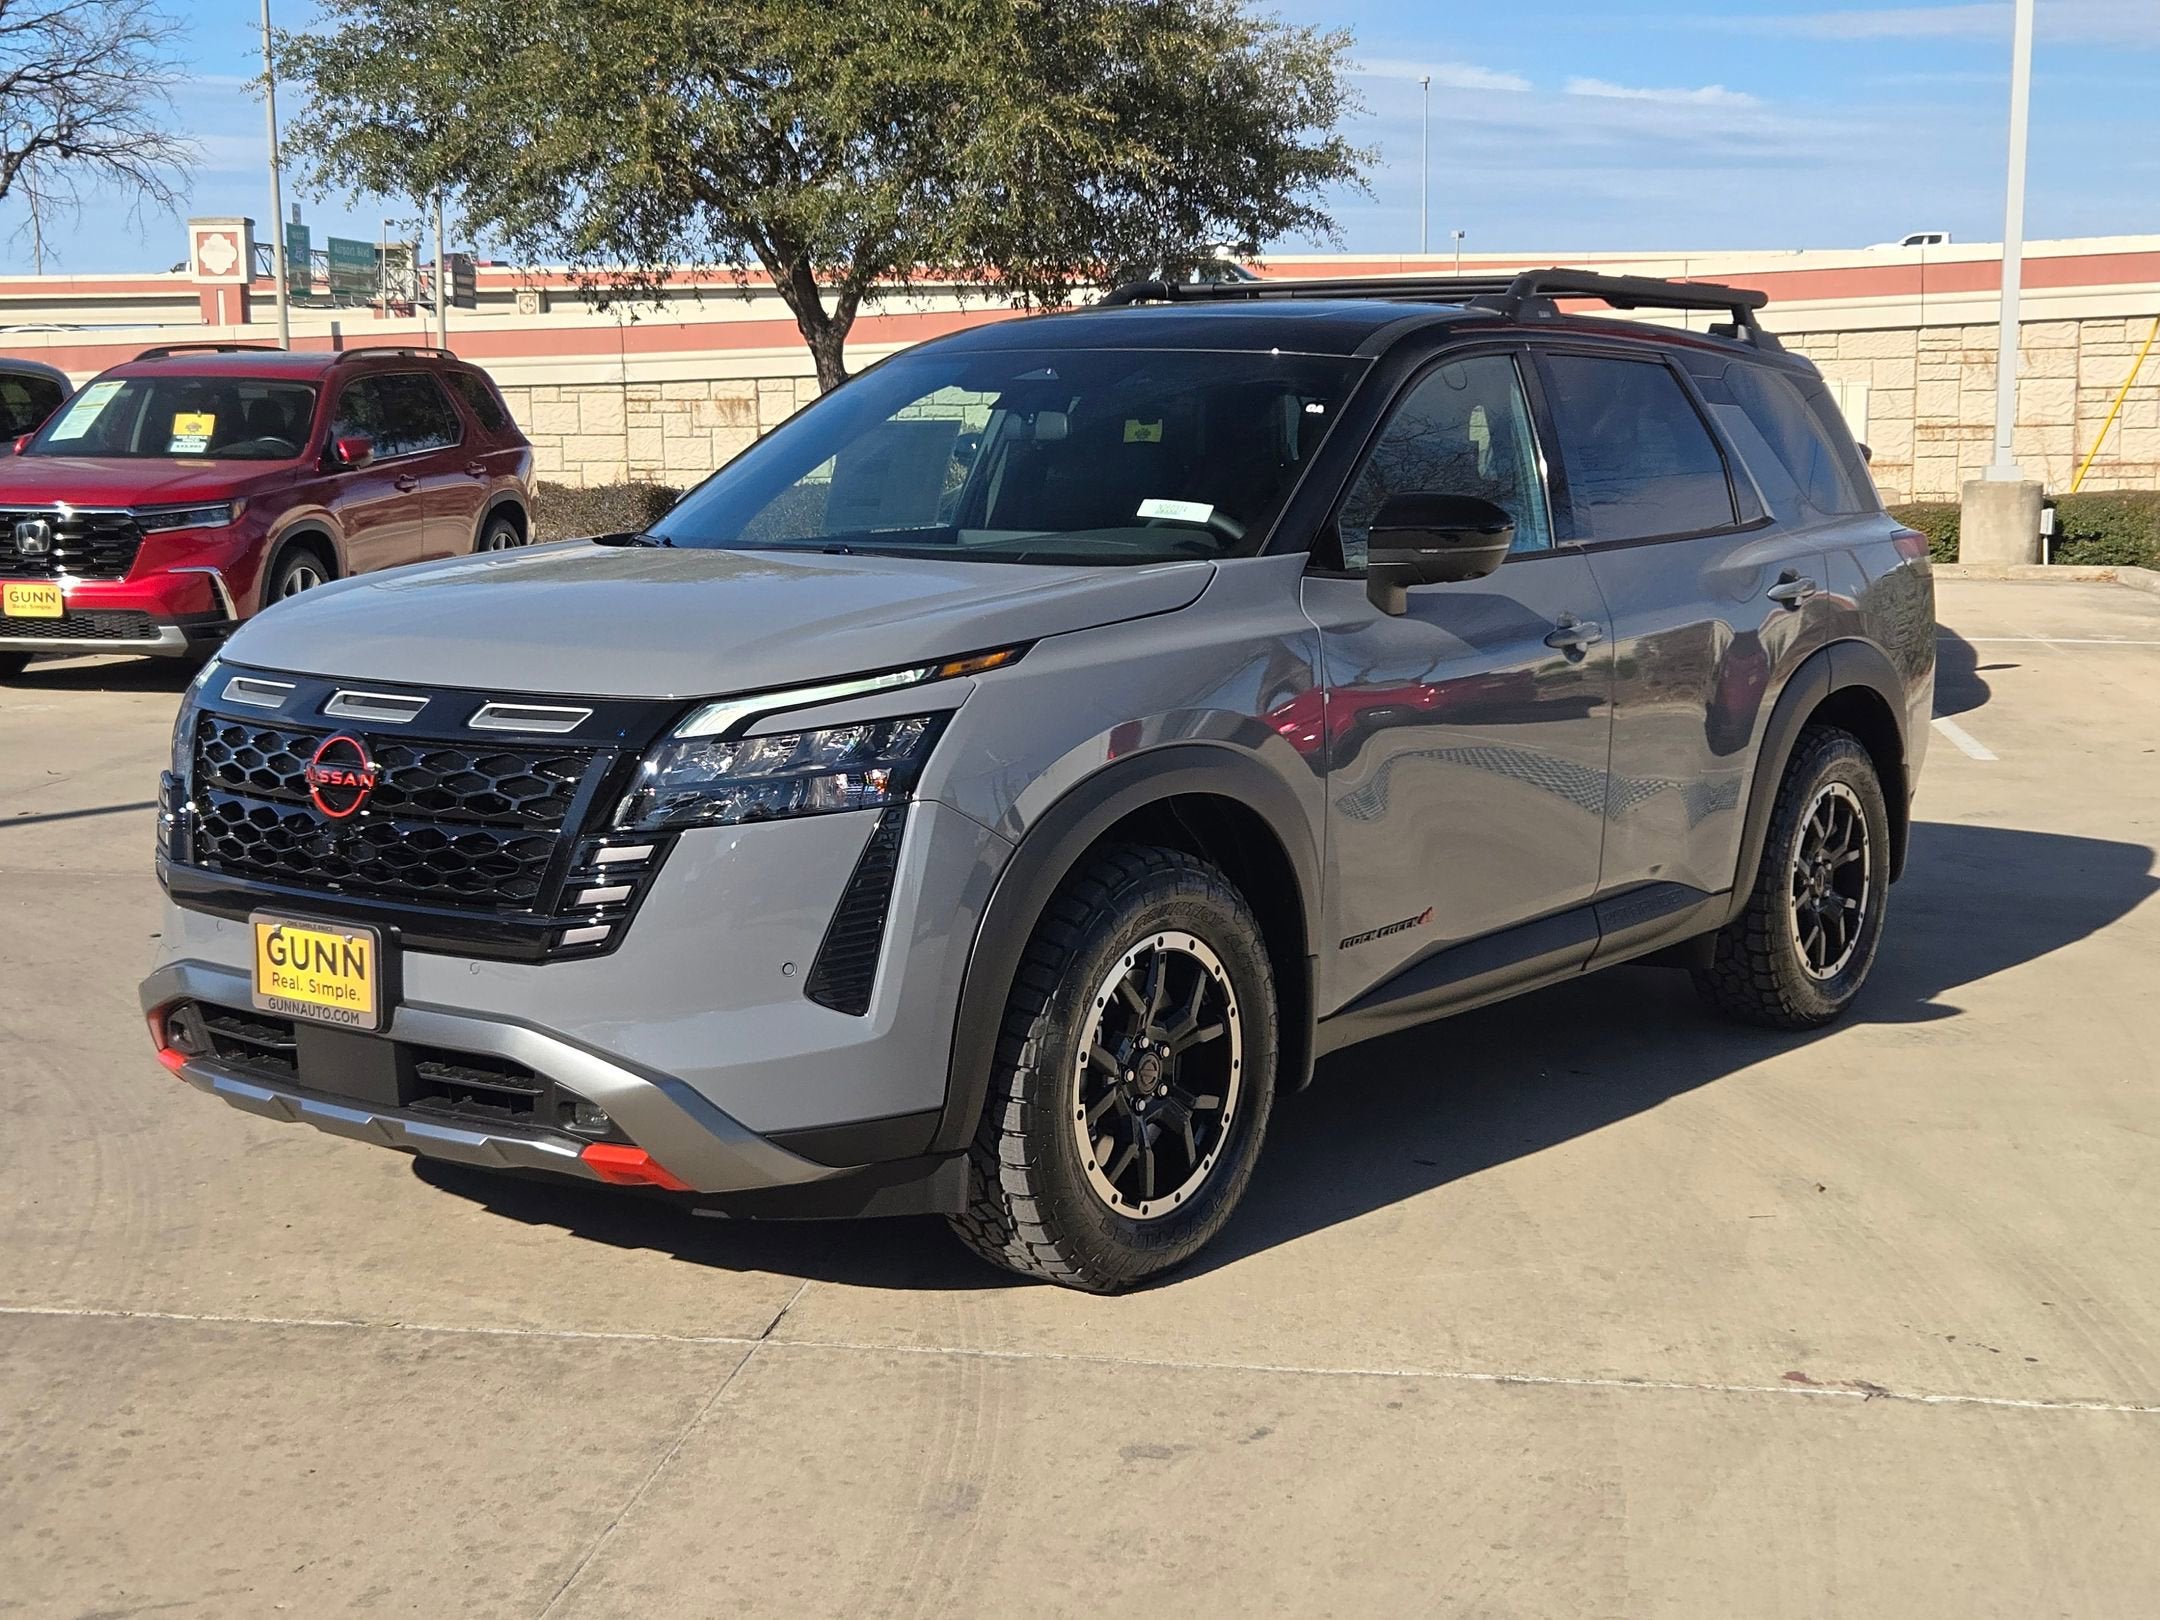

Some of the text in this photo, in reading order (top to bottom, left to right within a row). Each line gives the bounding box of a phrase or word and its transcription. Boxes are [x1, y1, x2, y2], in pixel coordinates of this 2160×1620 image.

[9, 591, 56, 603] GUNN
[266, 932, 365, 981] GUNN
[272, 972, 361, 1002] Real. Simple.
[268, 997, 360, 1025] GUNNAUTO.COM
